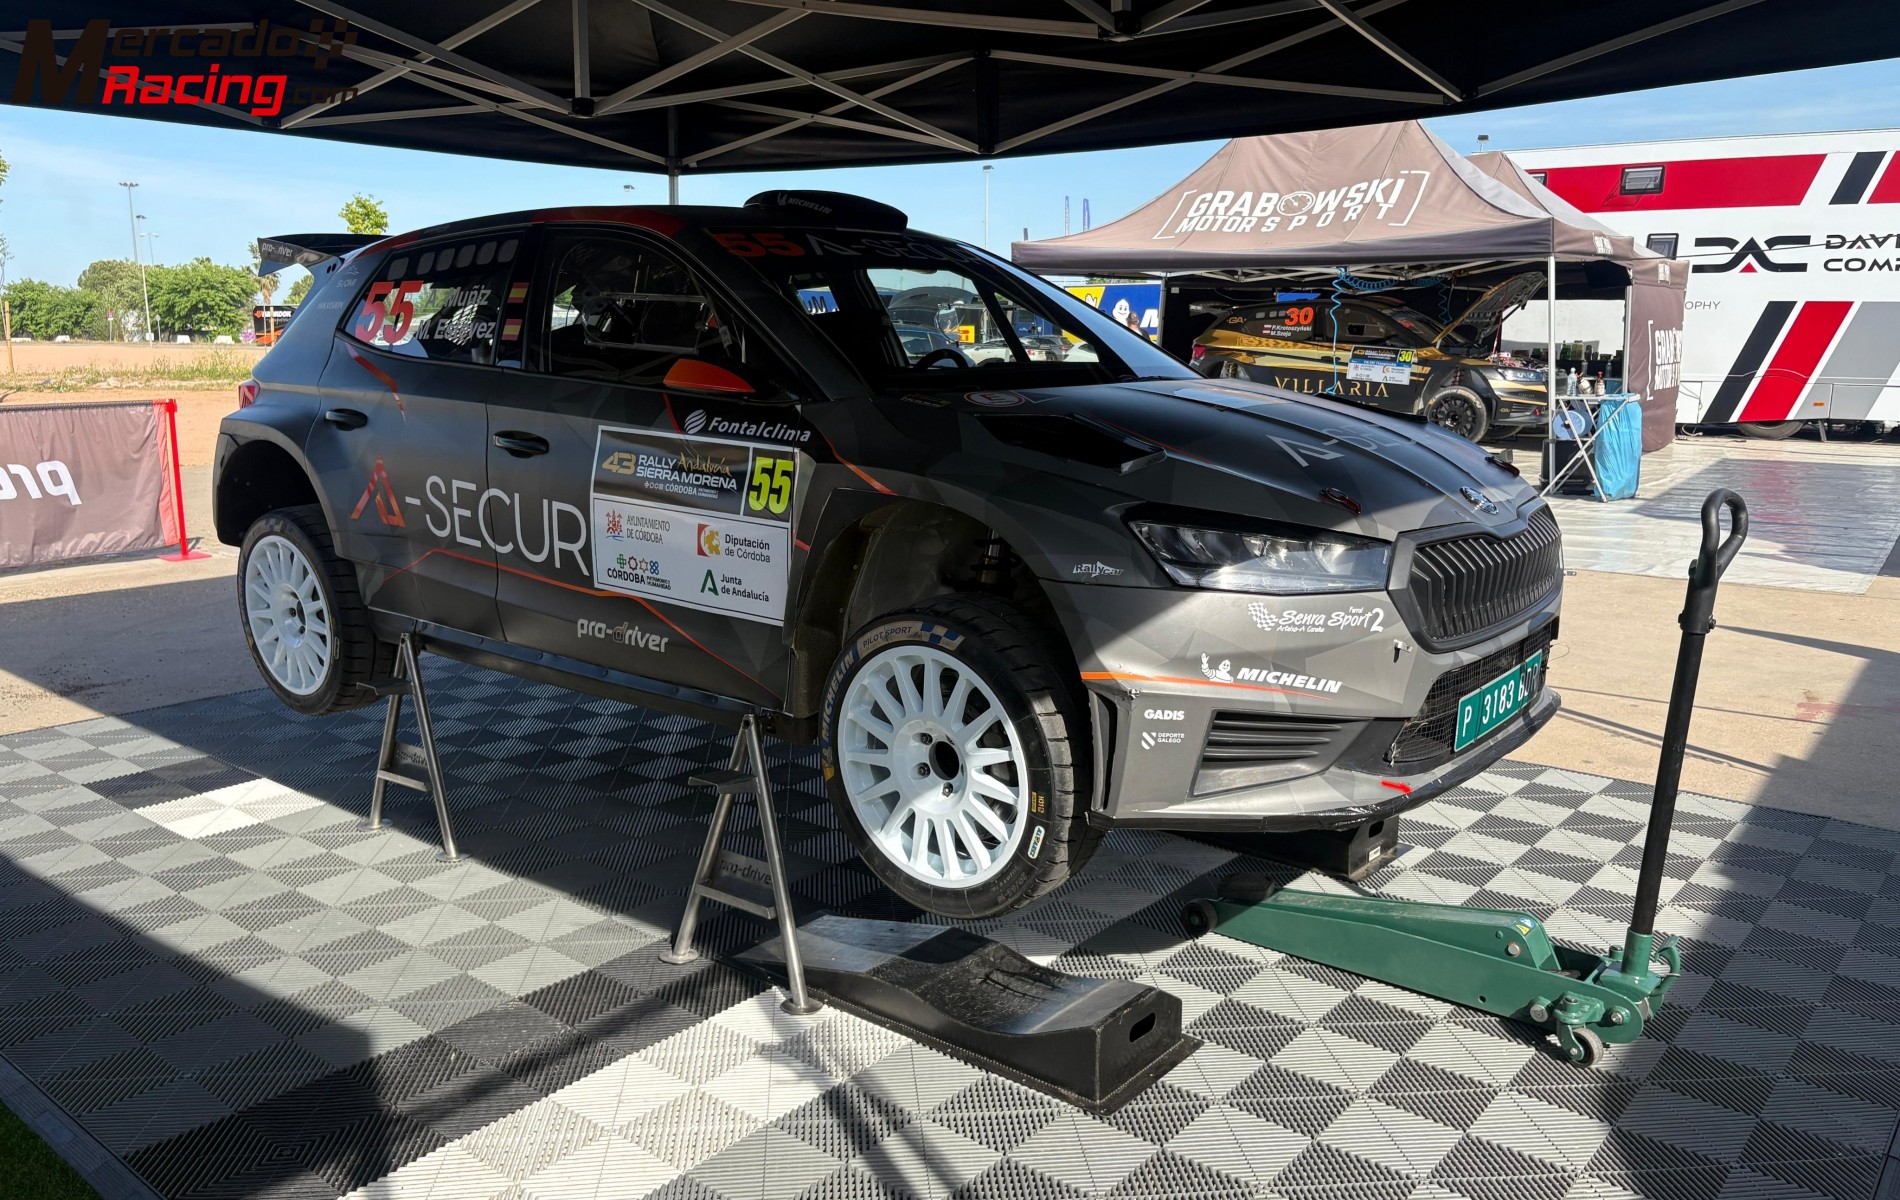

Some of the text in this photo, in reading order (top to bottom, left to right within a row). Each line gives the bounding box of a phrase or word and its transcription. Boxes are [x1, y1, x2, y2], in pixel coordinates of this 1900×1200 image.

[787, 197, 832, 216] MICHELIN
[713, 233, 805, 257] 55
[355, 280, 424, 345] 55
[444, 284, 493, 307] Muñiz
[1285, 307, 1314, 326] 30
[1399, 350, 1412, 362] 30
[708, 417, 811, 442] Fontalclima
[602, 451, 637, 475] 43
[638, 454, 677, 470] RALLY
[636, 466, 738, 491] SIERRA MORENA
[748, 456, 794, 514] 55
[665, 482, 697, 496] CÓRDOBA
[626, 515, 671, 532] AYUNTAMIENTO
[626, 529, 664, 544] DE CÓRDOBA
[725, 534, 770, 550] Diputación
[725, 547, 771, 563] de Córdoba
[607, 567, 646, 585] CÓRDOBA
[721, 574, 742, 586] Junta
[721, 586, 769, 602] de Andalucía
[1279, 607, 1384, 632] Senra Sport 2
[577, 618, 669, 652] pro-driver
[862, 626, 912, 648] PILOT SPORT
[1237, 666, 1343, 694] MICHELIN
[821, 650, 855, 741] MICHELIN
[1144, 709, 1185, 720] GADIS
[1462, 705, 1472, 737] P
[1482, 680, 1515, 724] 3183
